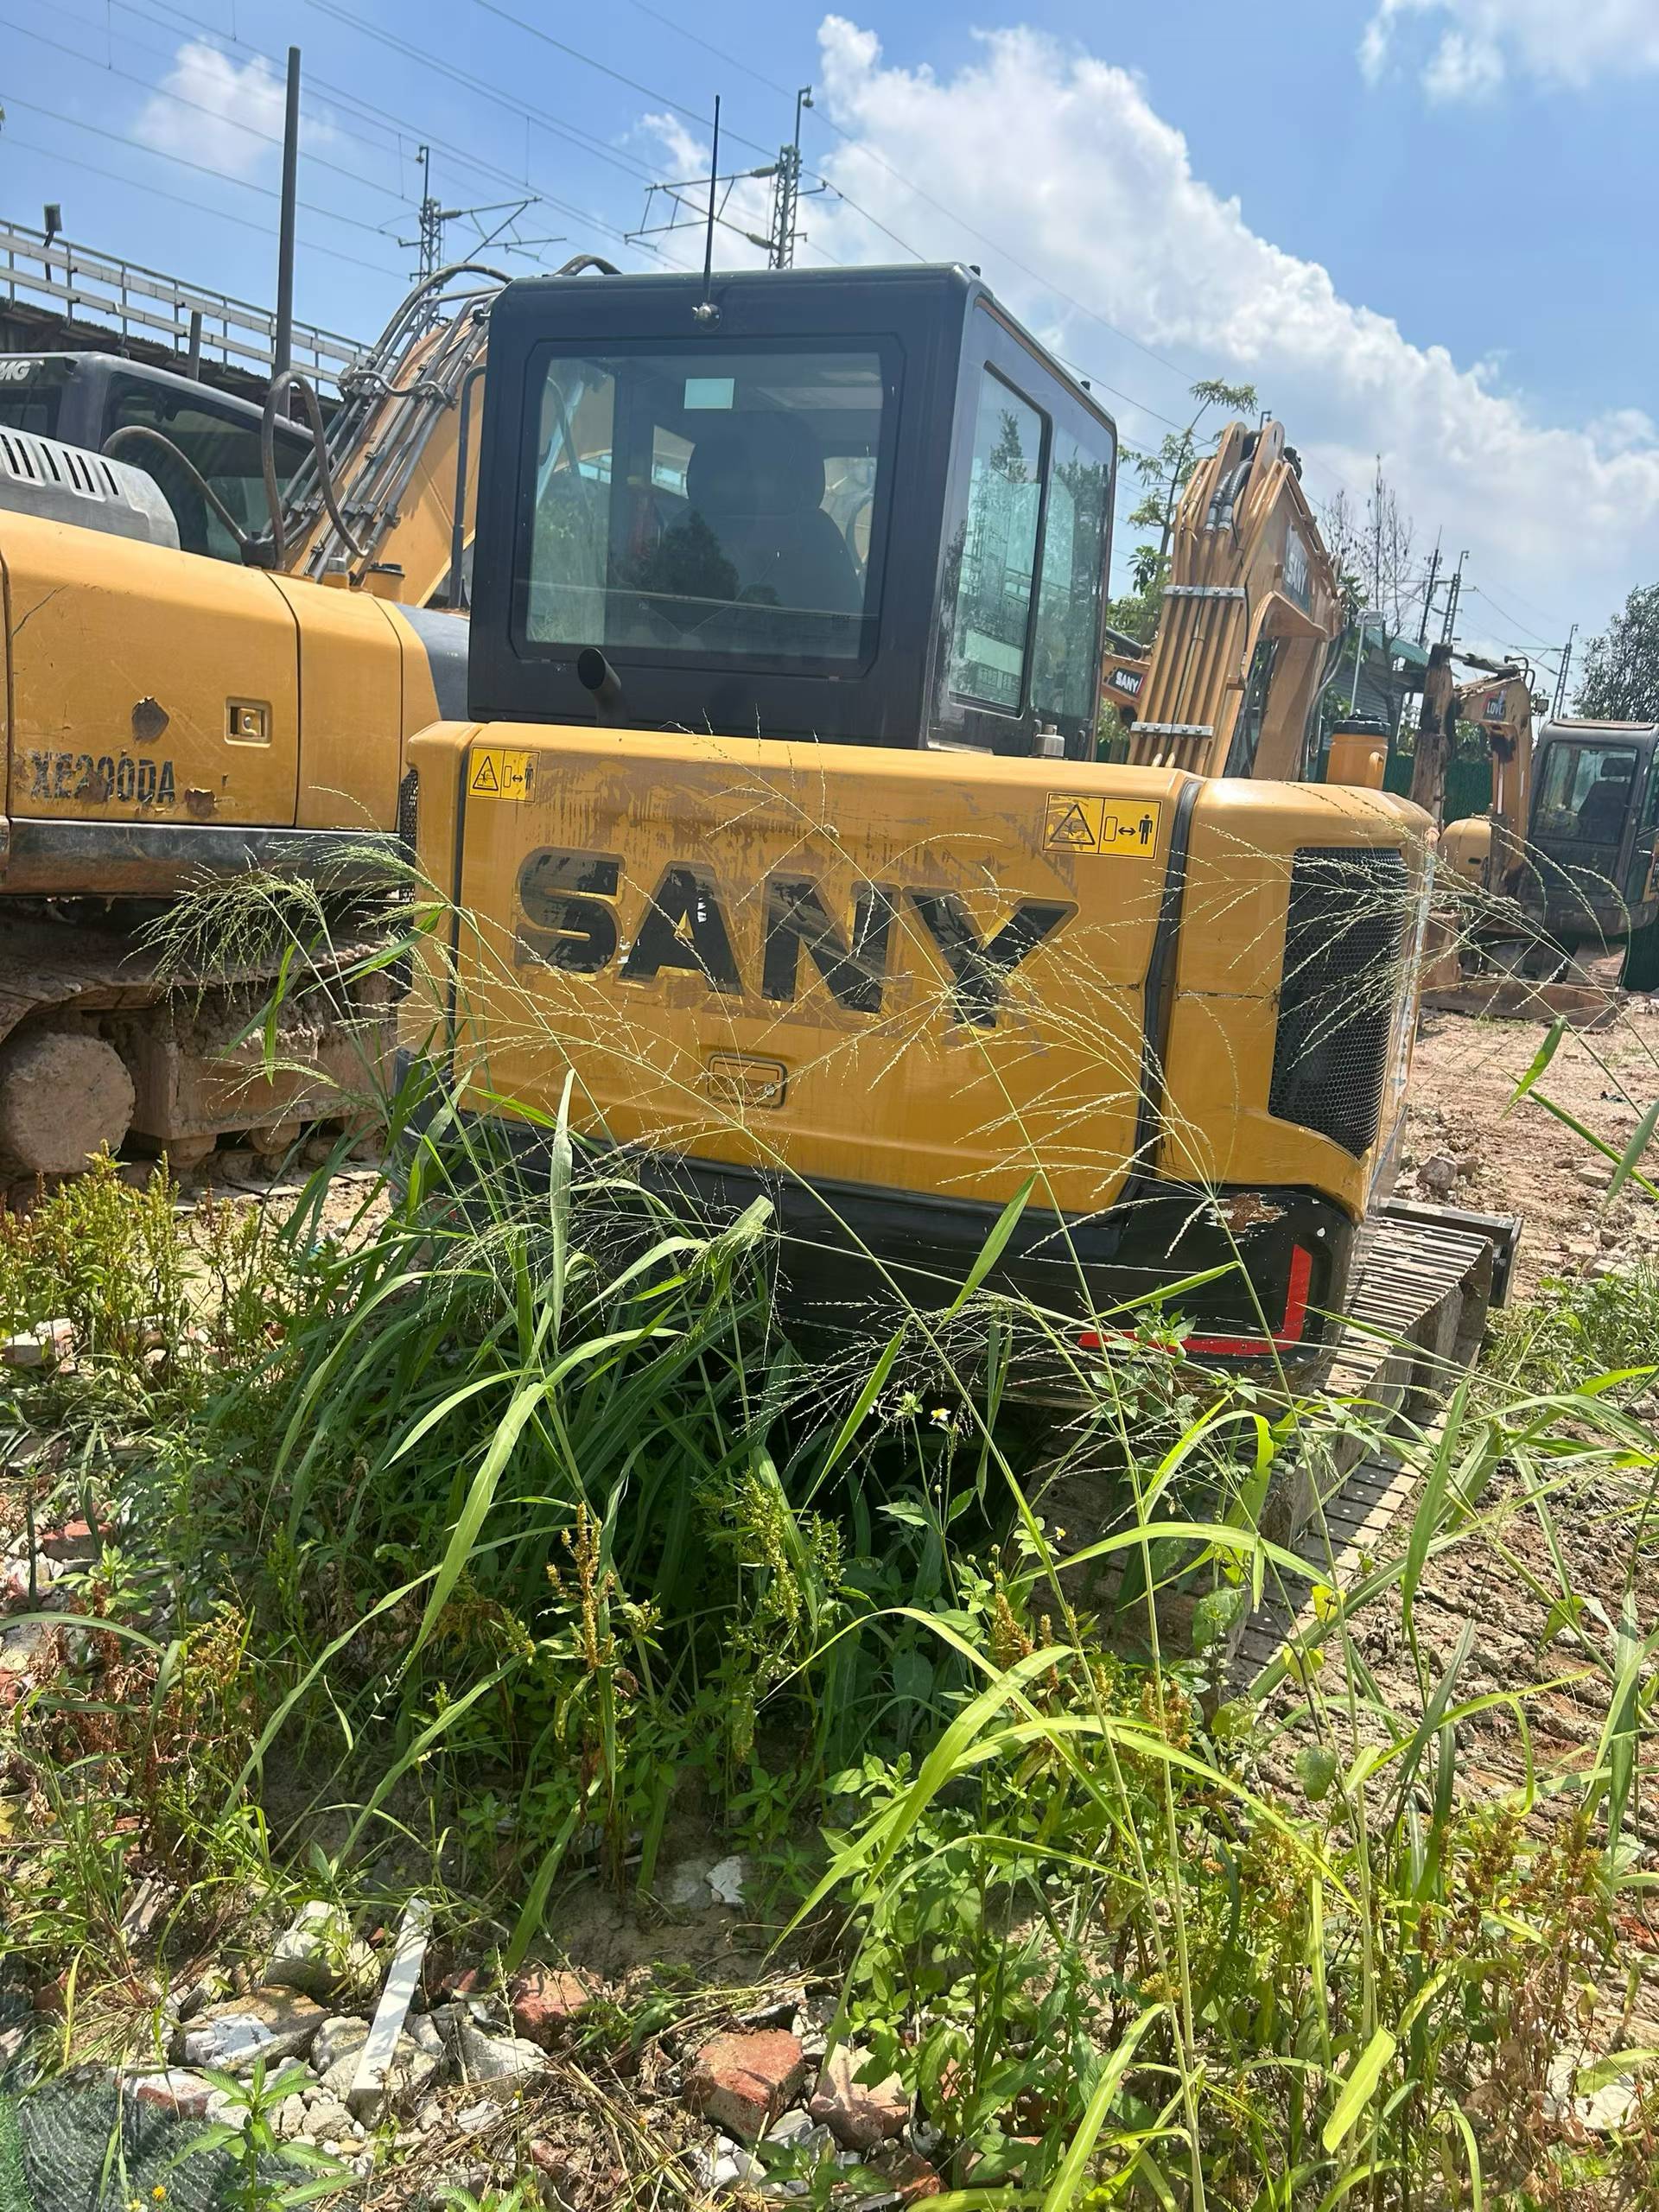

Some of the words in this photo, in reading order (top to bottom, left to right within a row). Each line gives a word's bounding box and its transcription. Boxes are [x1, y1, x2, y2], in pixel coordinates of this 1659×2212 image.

[0, 360, 31, 380] MG
[1116, 671, 1139, 693] SANY
[516, 846, 1078, 1030] SANY
